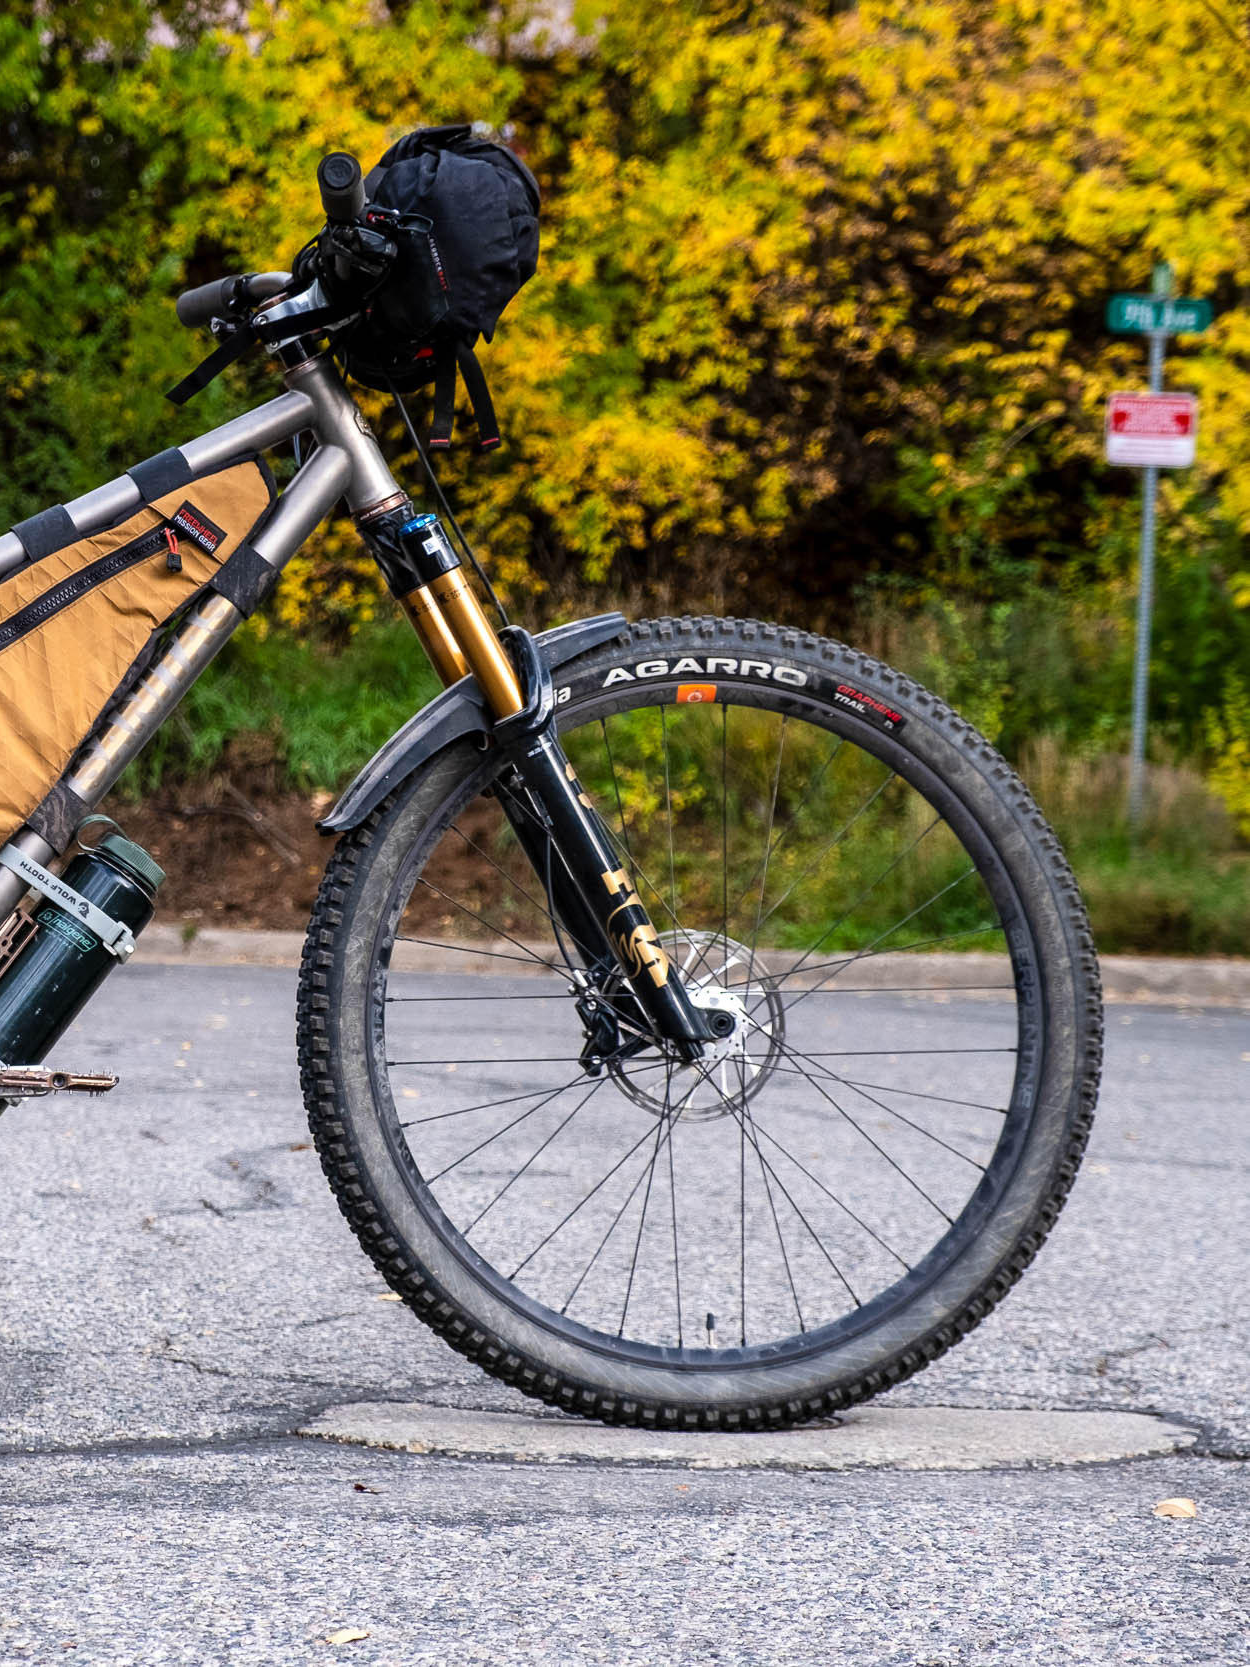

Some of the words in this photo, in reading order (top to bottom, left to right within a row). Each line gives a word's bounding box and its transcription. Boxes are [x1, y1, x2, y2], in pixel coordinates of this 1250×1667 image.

[174, 514, 199, 538] MISSION
[198, 535, 216, 552] GEAR
[178, 508, 219, 545] FREEWHEEL
[602, 657, 808, 688] AGARRO
[834, 692, 866, 714] TRAIL
[20, 860, 50, 887] TOOTH
[51, 882, 77, 905] WOLF
[55, 916, 92, 948] nalgene
